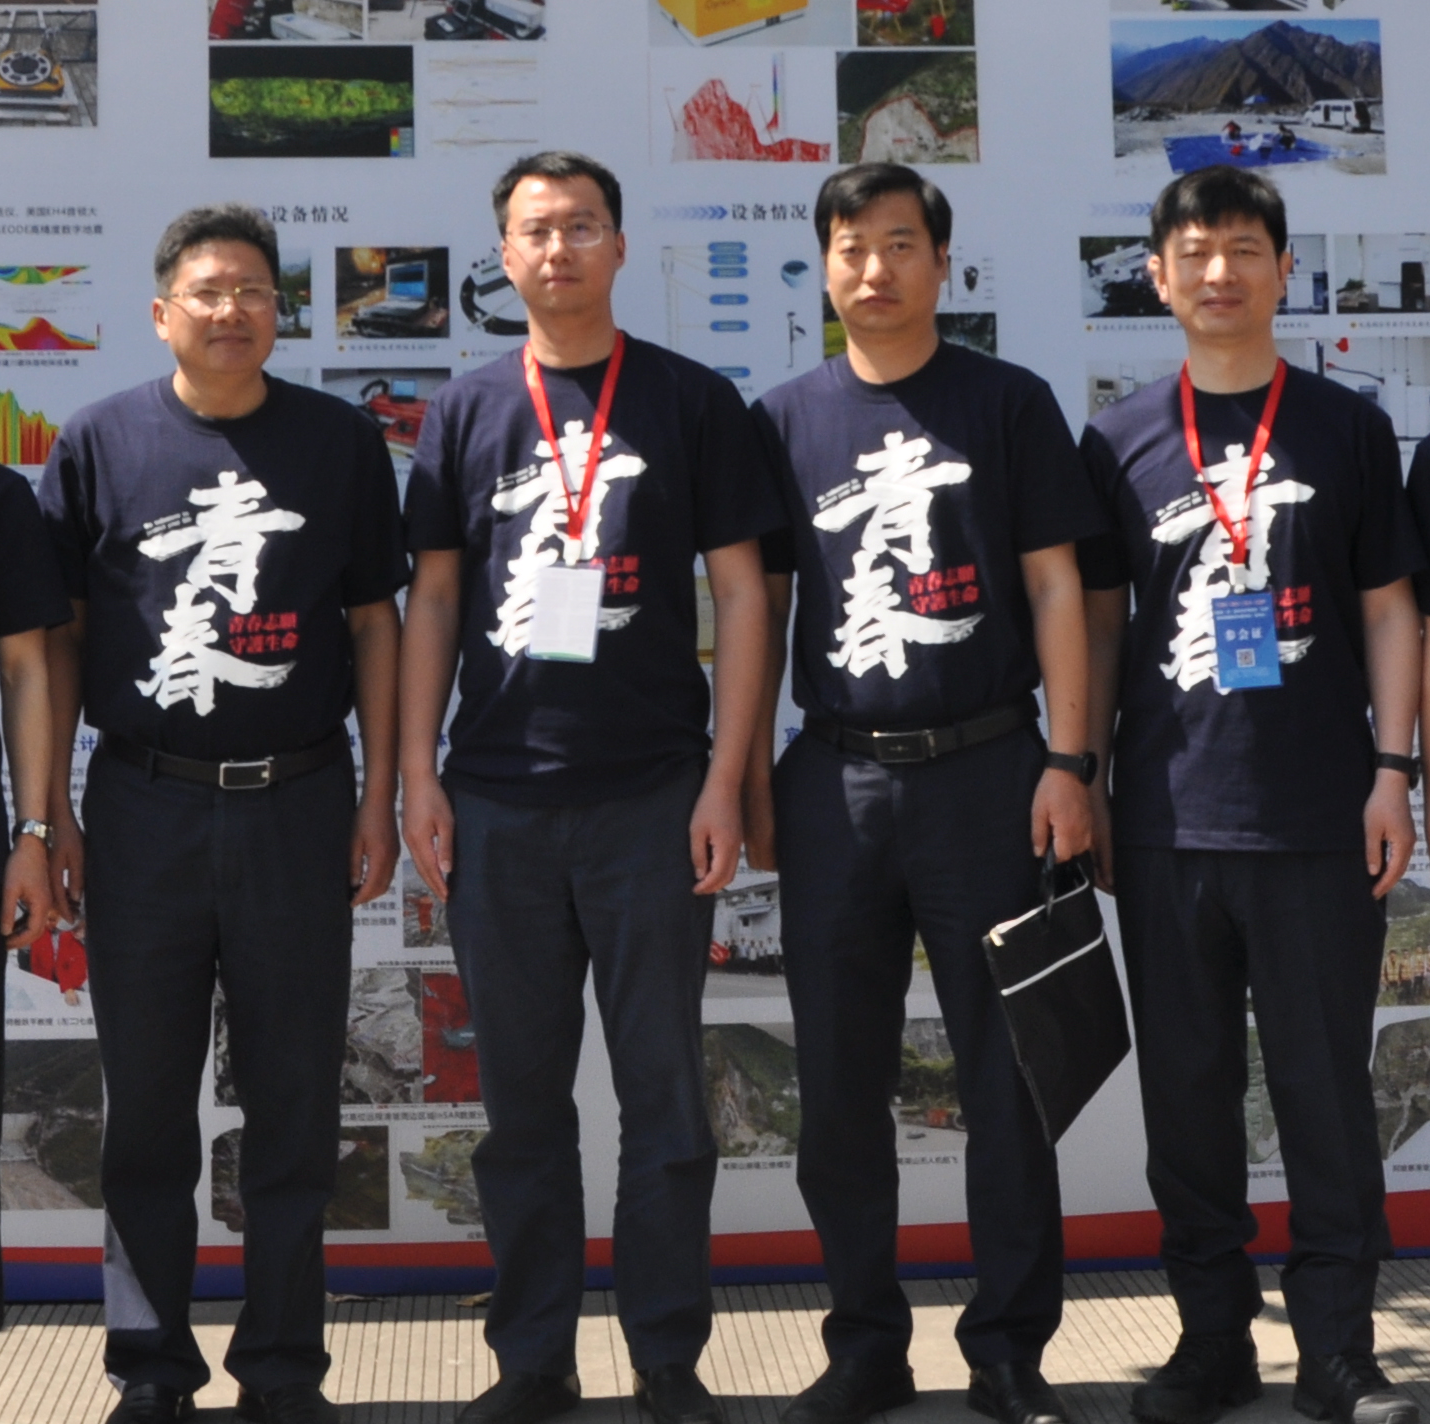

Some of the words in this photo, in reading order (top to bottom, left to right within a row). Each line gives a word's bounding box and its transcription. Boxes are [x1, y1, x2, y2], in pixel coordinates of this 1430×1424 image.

[271, 206, 349, 223] 设备情况
[731, 204, 809, 221] 设备情况
[135, 471, 306, 716] 青春
[812, 431, 985, 679] 青春
